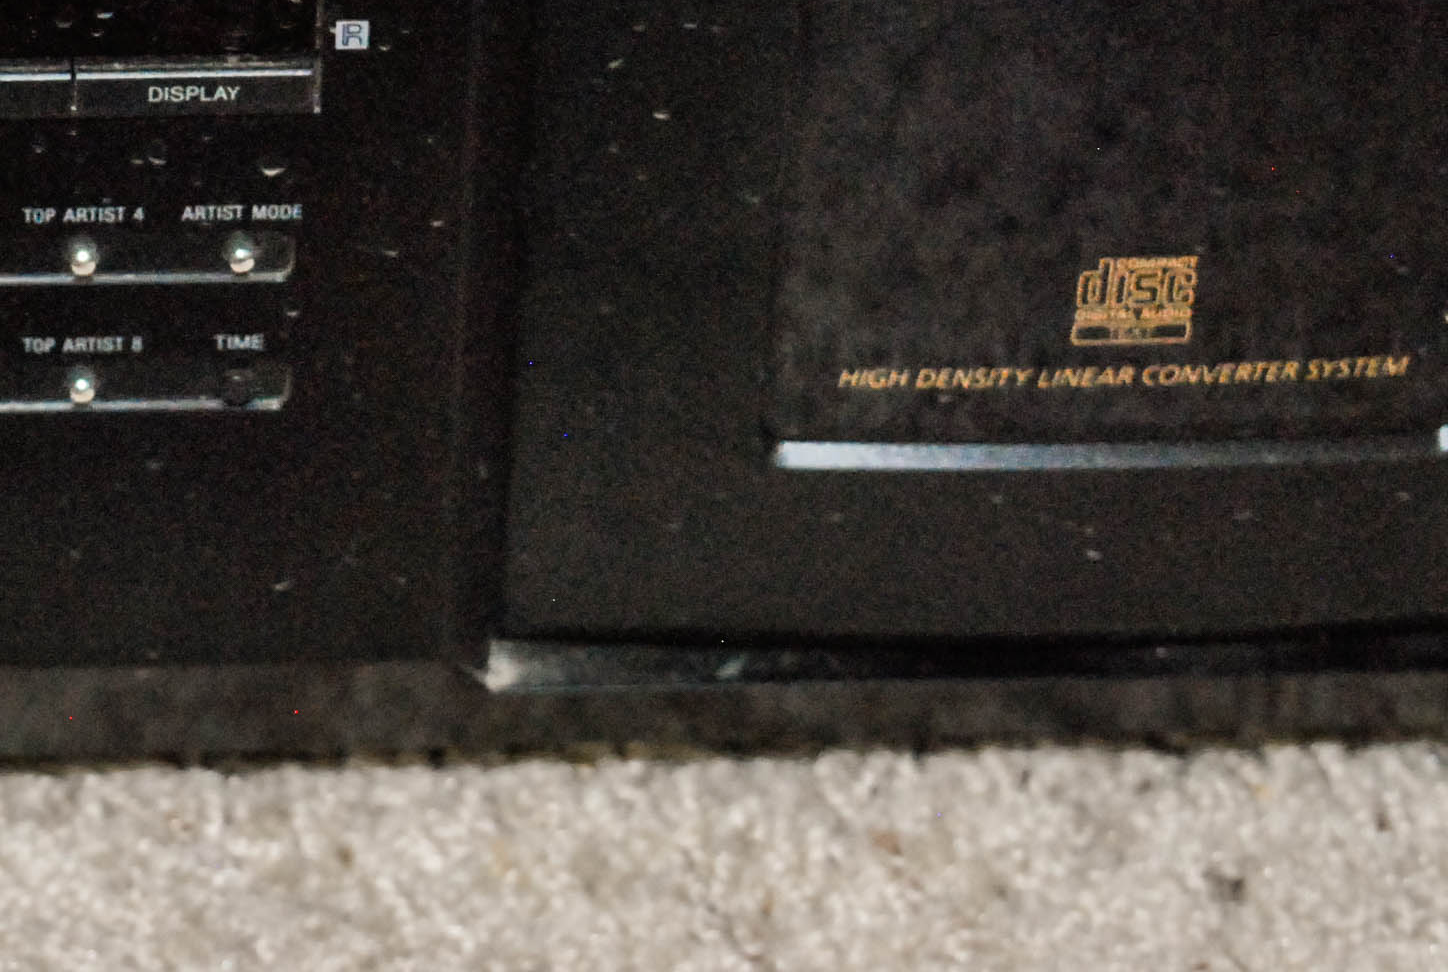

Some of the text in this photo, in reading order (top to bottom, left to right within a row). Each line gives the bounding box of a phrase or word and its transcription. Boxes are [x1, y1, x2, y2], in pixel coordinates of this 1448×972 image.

[147, 86, 241, 104] DISPLAY
[22, 207, 145, 223] TOP ARTIST 4
[181, 204, 303, 221] ARTIST MODE
[22, 338, 56, 353] TOP
[62, 337, 125, 352] ARTIST
[214, 334, 265, 350] TIME
[837, 355, 1410, 390] HIGH DENSITY LINEAR CONVERTER SYSTEM
